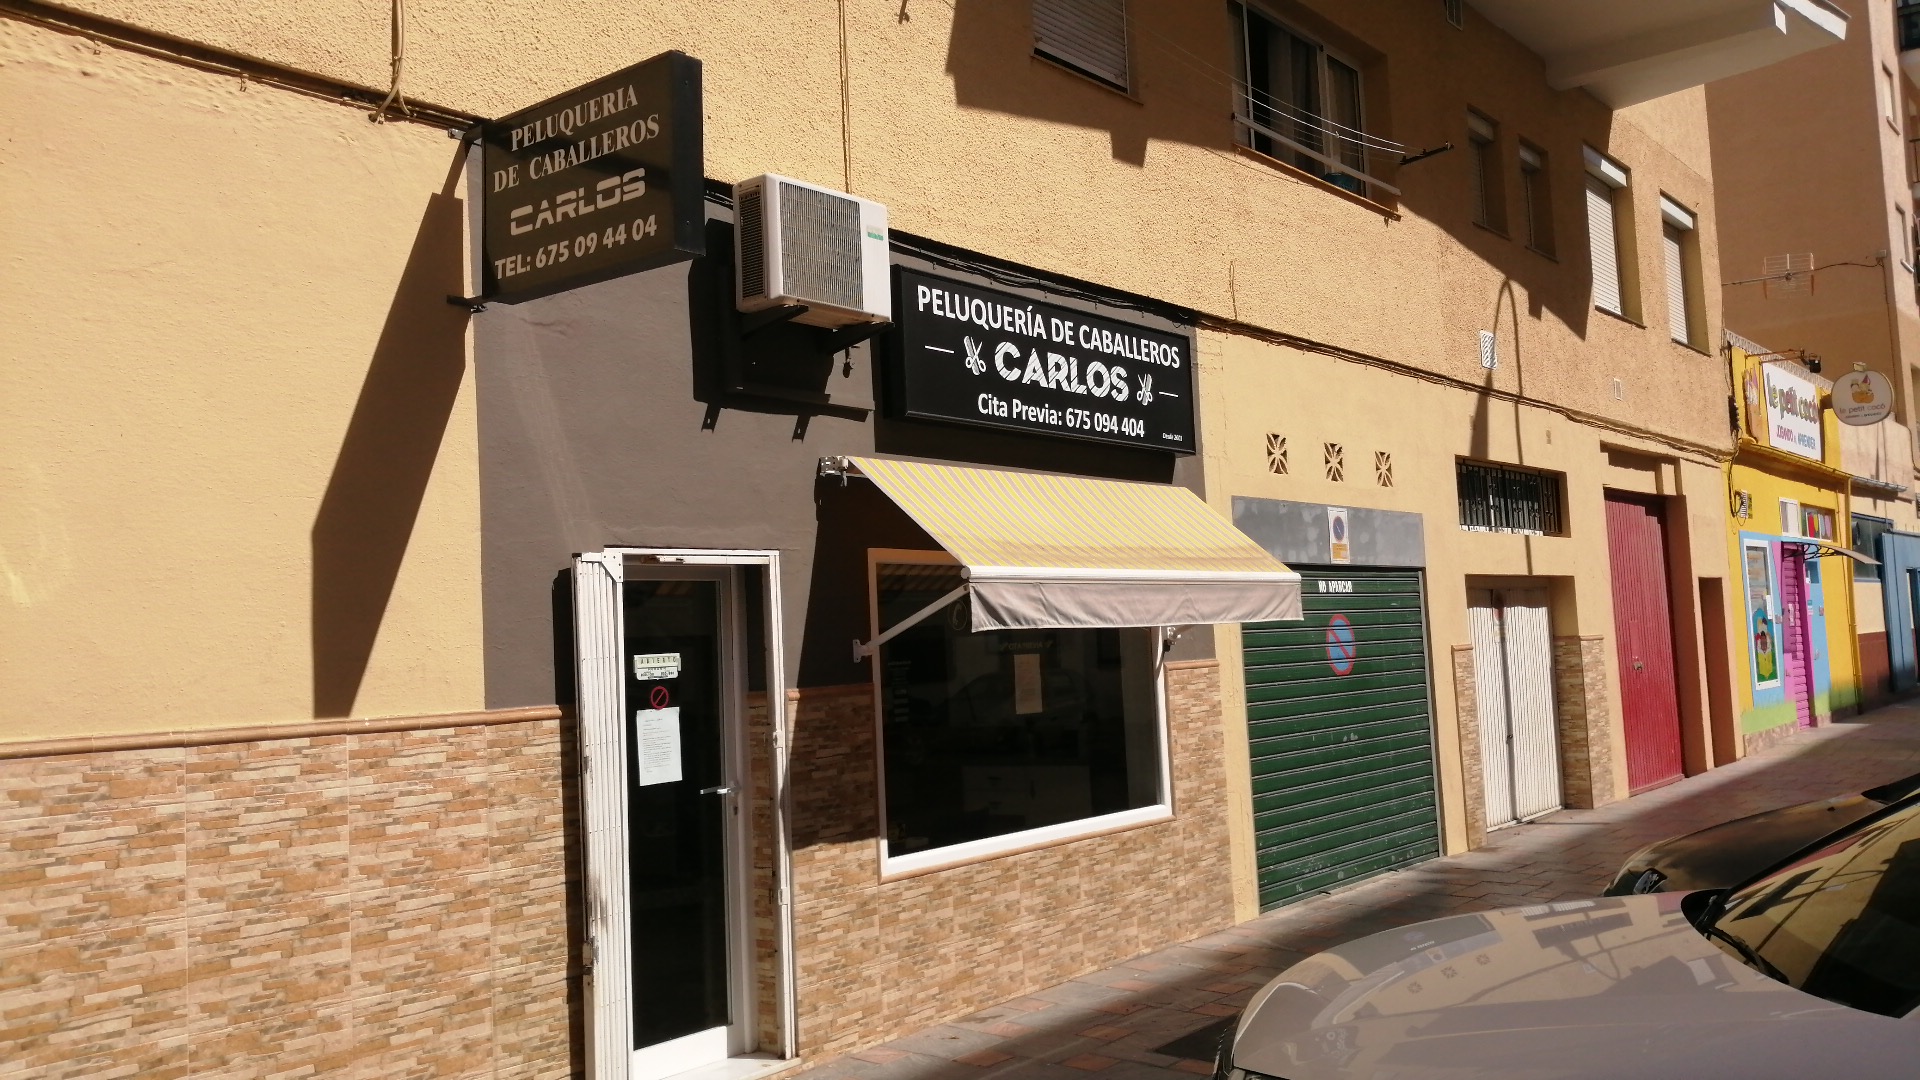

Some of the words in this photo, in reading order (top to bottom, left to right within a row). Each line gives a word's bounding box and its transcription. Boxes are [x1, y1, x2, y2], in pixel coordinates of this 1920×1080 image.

[510, 84, 639, 152] PELUQUERIA
[493, 164, 520, 193] DE
[529, 113, 660, 180] CABALLEROS
[510, 166, 646, 236] CARLOS
[494, 254, 531, 280] TEL:
[535, 240, 569, 269] 675
[574, 232, 598, 258] 09
[602, 223, 627, 249] 44
[631, 214, 657, 241] 04
[917, 284, 1047, 340] PELUQUERÍA
[1051, 317, 1075, 345] DE
[1079, 324, 1181, 369] CABALLEROS
[994, 341, 1130, 402] CARLOS
[1766, 372, 1778, 409] le
[1778, 386, 1799, 420] petit
[977, 392, 1008, 418] Cita
[1012, 398, 1062, 426] Previa:
[1065, 406, 1091, 430] 675
[1094, 411, 1118, 434] 094
[1121, 417, 1145, 437] 404
[1162, 432, 1173, 441] Desde
[1848, 405, 1865, 414] petit
[1318, 580, 1327, 592] NO
[1328, 580, 1353, 593] APARCAR
[640, 656, 677, 665] ABIERTO
